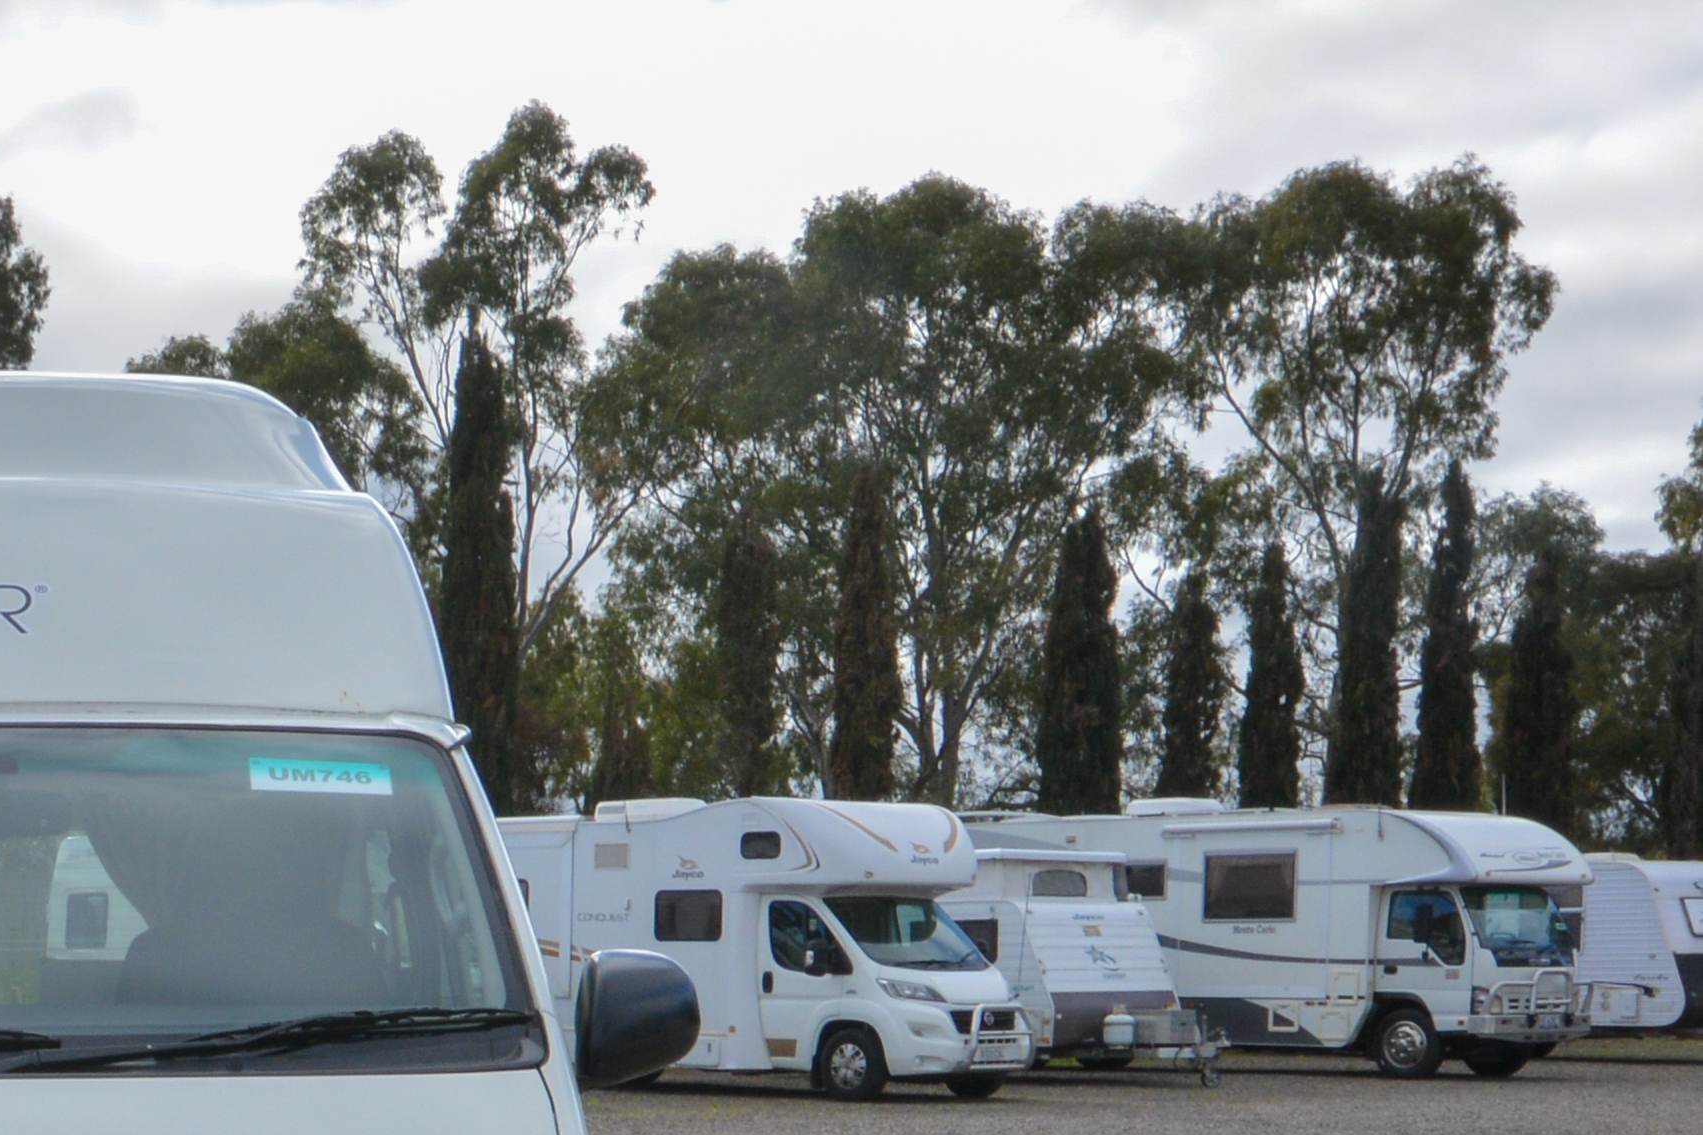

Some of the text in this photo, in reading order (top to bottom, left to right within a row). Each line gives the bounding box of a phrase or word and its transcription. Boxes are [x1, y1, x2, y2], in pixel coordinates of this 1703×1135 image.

[267, 766, 372, 785] UM746
[671, 870, 705, 880] Jayco
[577, 913, 630, 922] CONQUEST
